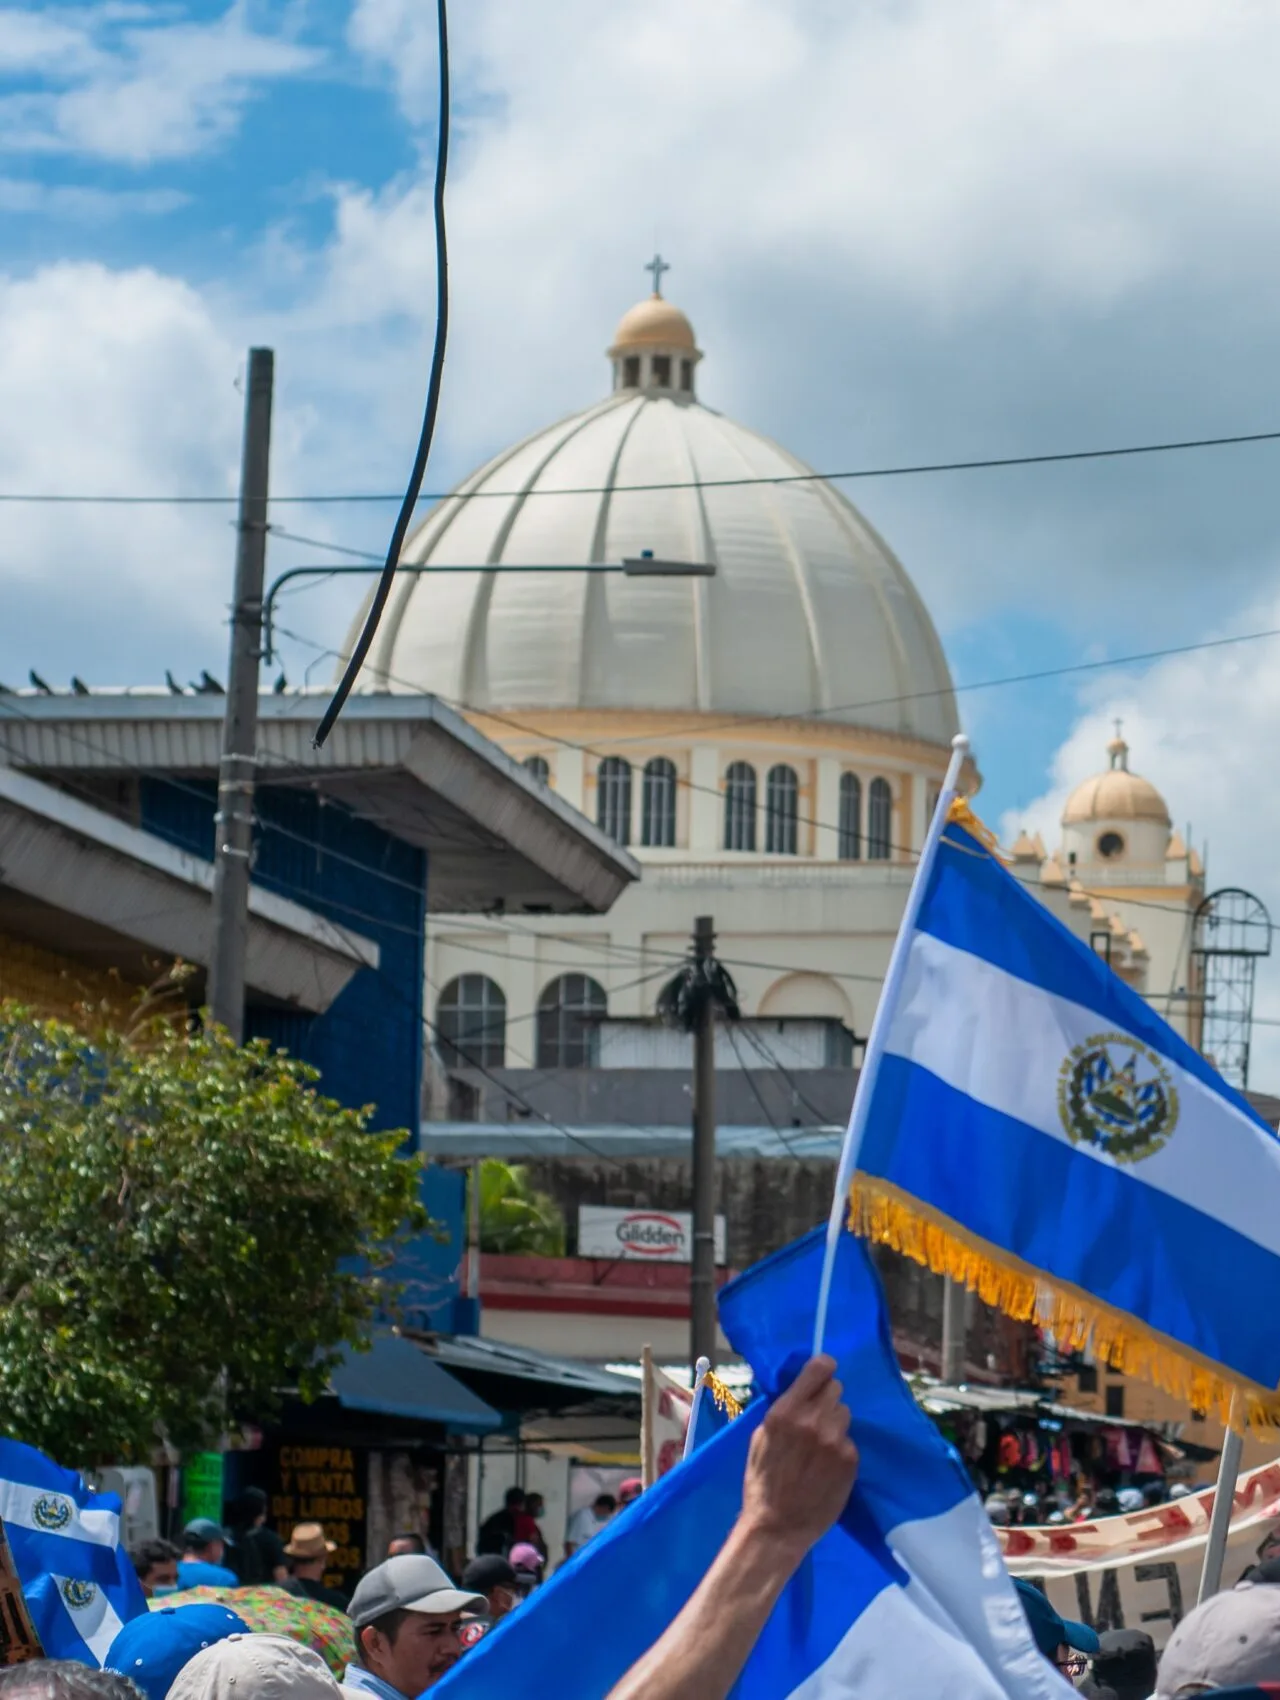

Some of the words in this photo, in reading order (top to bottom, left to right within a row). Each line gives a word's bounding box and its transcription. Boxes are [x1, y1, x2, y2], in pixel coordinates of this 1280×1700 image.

[616, 1221, 685, 1244] Glidden
[279, 1446, 354, 1469] COMPRA
[297, 1471, 355, 1494] VENTA
[300, 1496, 363, 1521] LIBROS
